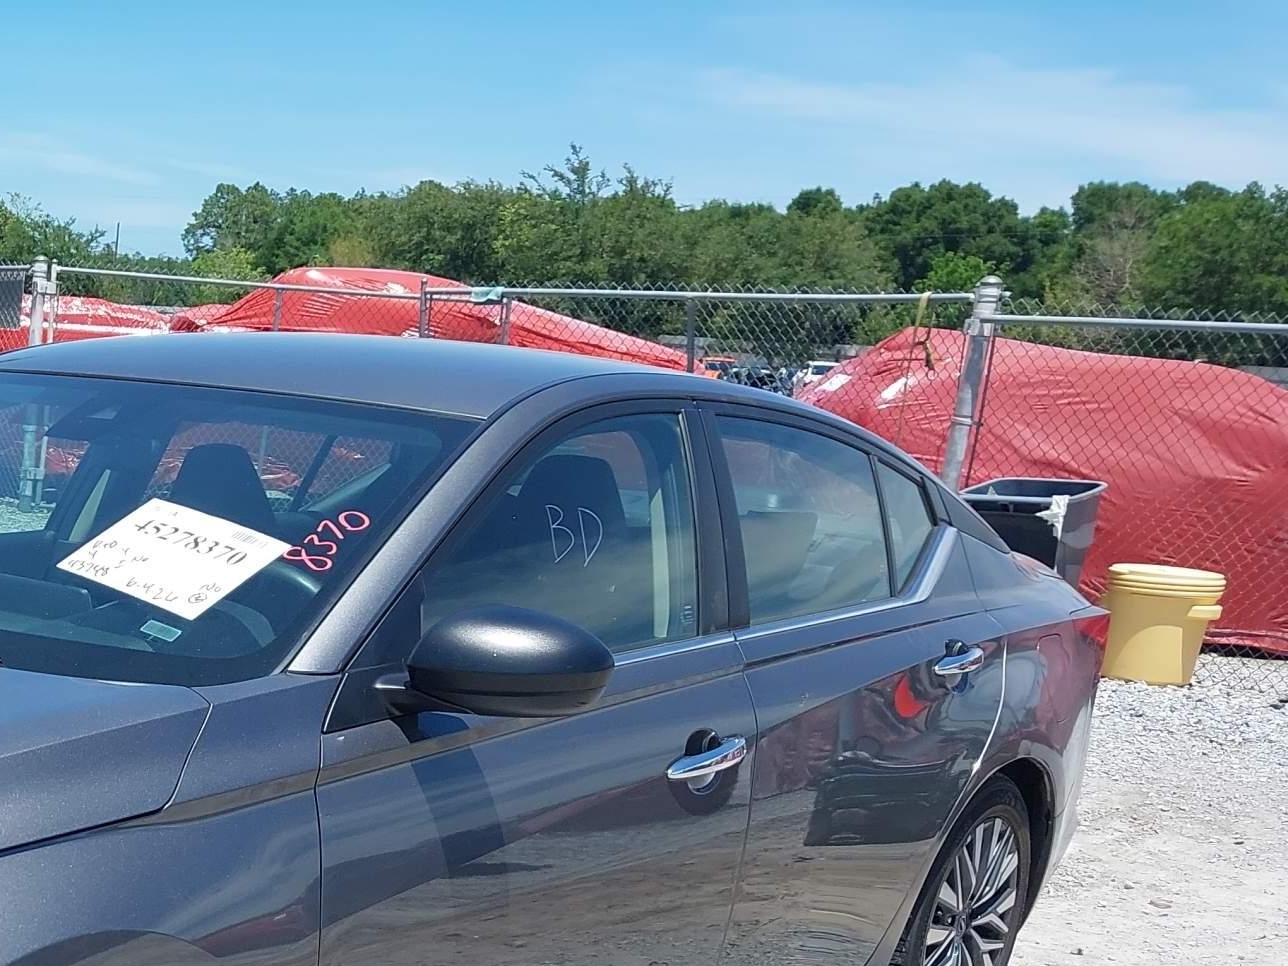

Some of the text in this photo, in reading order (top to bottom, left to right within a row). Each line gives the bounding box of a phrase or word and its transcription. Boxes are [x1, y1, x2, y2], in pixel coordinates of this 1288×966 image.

[134, 519, 248, 566] 45278370
[282, 510, 371, 572] 8370
[544, 503, 604, 568] BD
